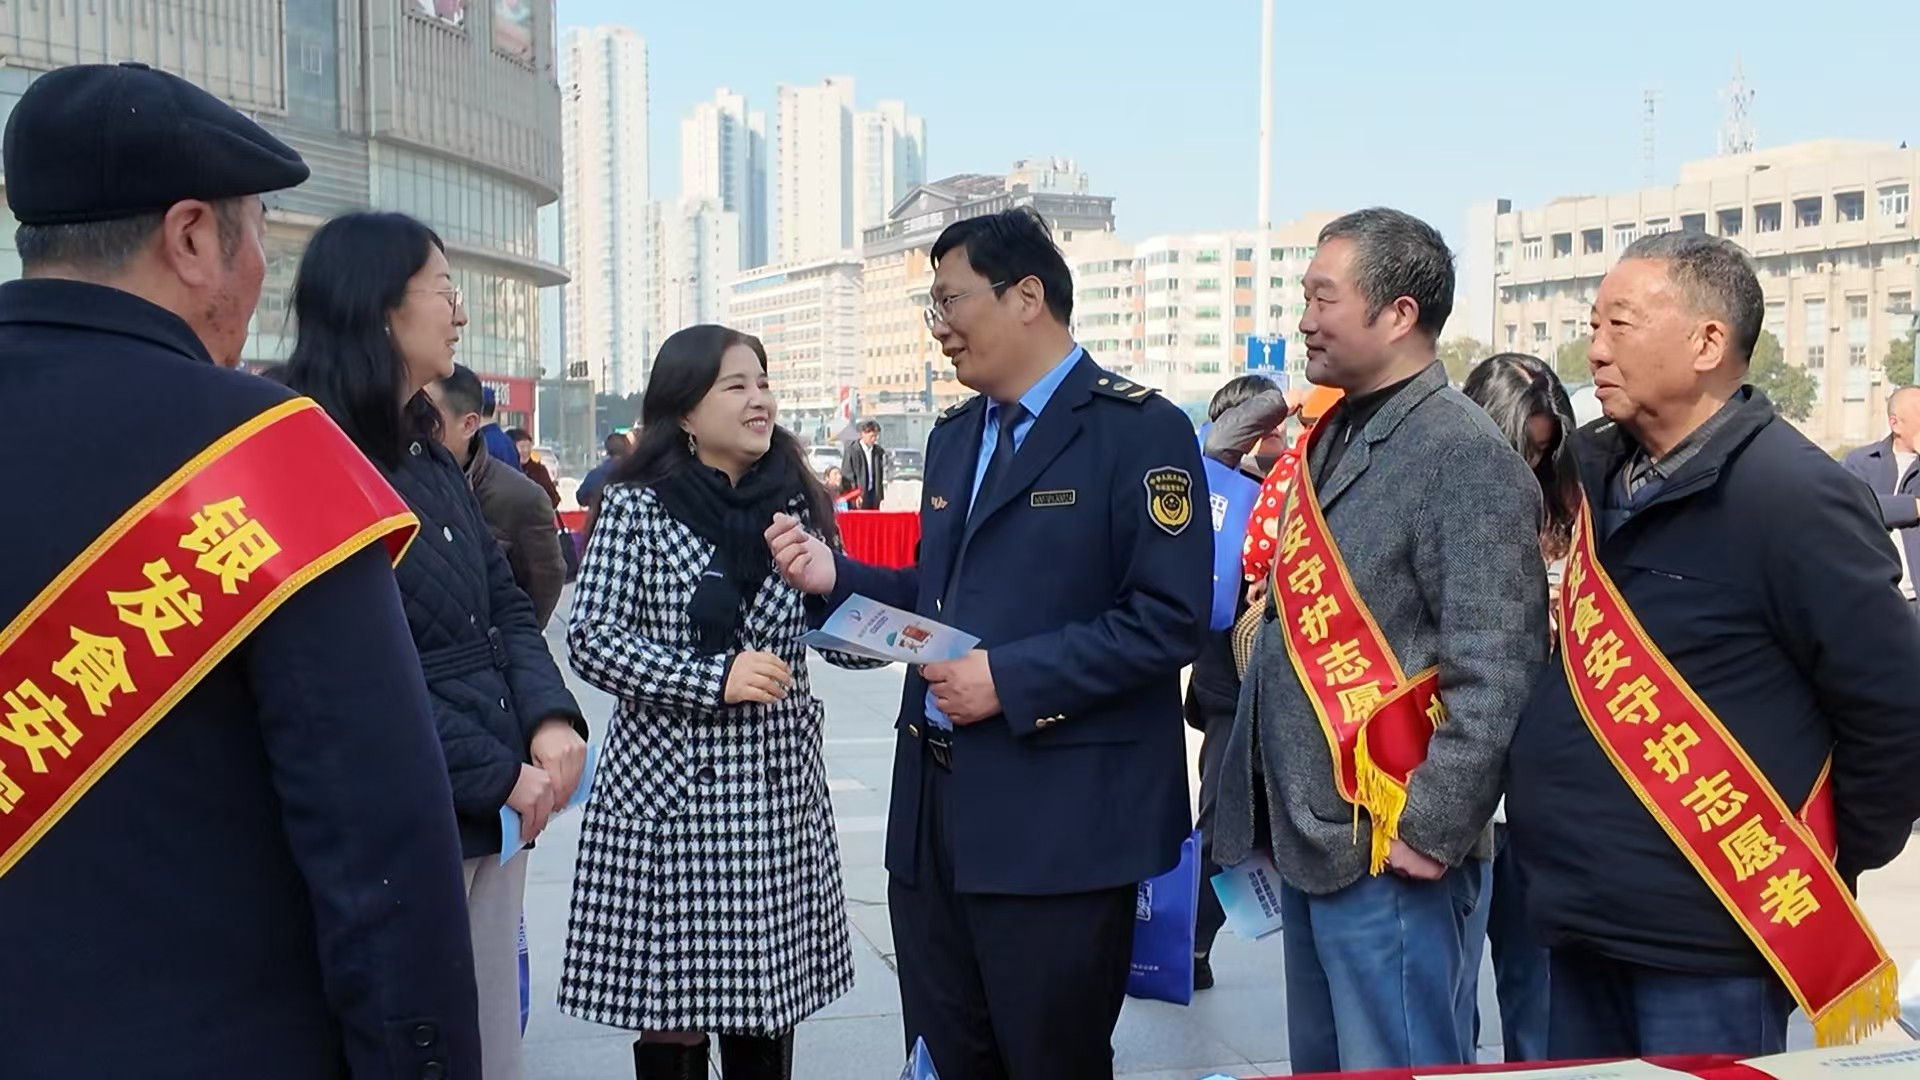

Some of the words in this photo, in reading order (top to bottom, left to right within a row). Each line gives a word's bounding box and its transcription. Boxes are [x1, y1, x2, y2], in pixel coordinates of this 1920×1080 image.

[1569, 531, 1821, 928] 发食安守护志愿者
